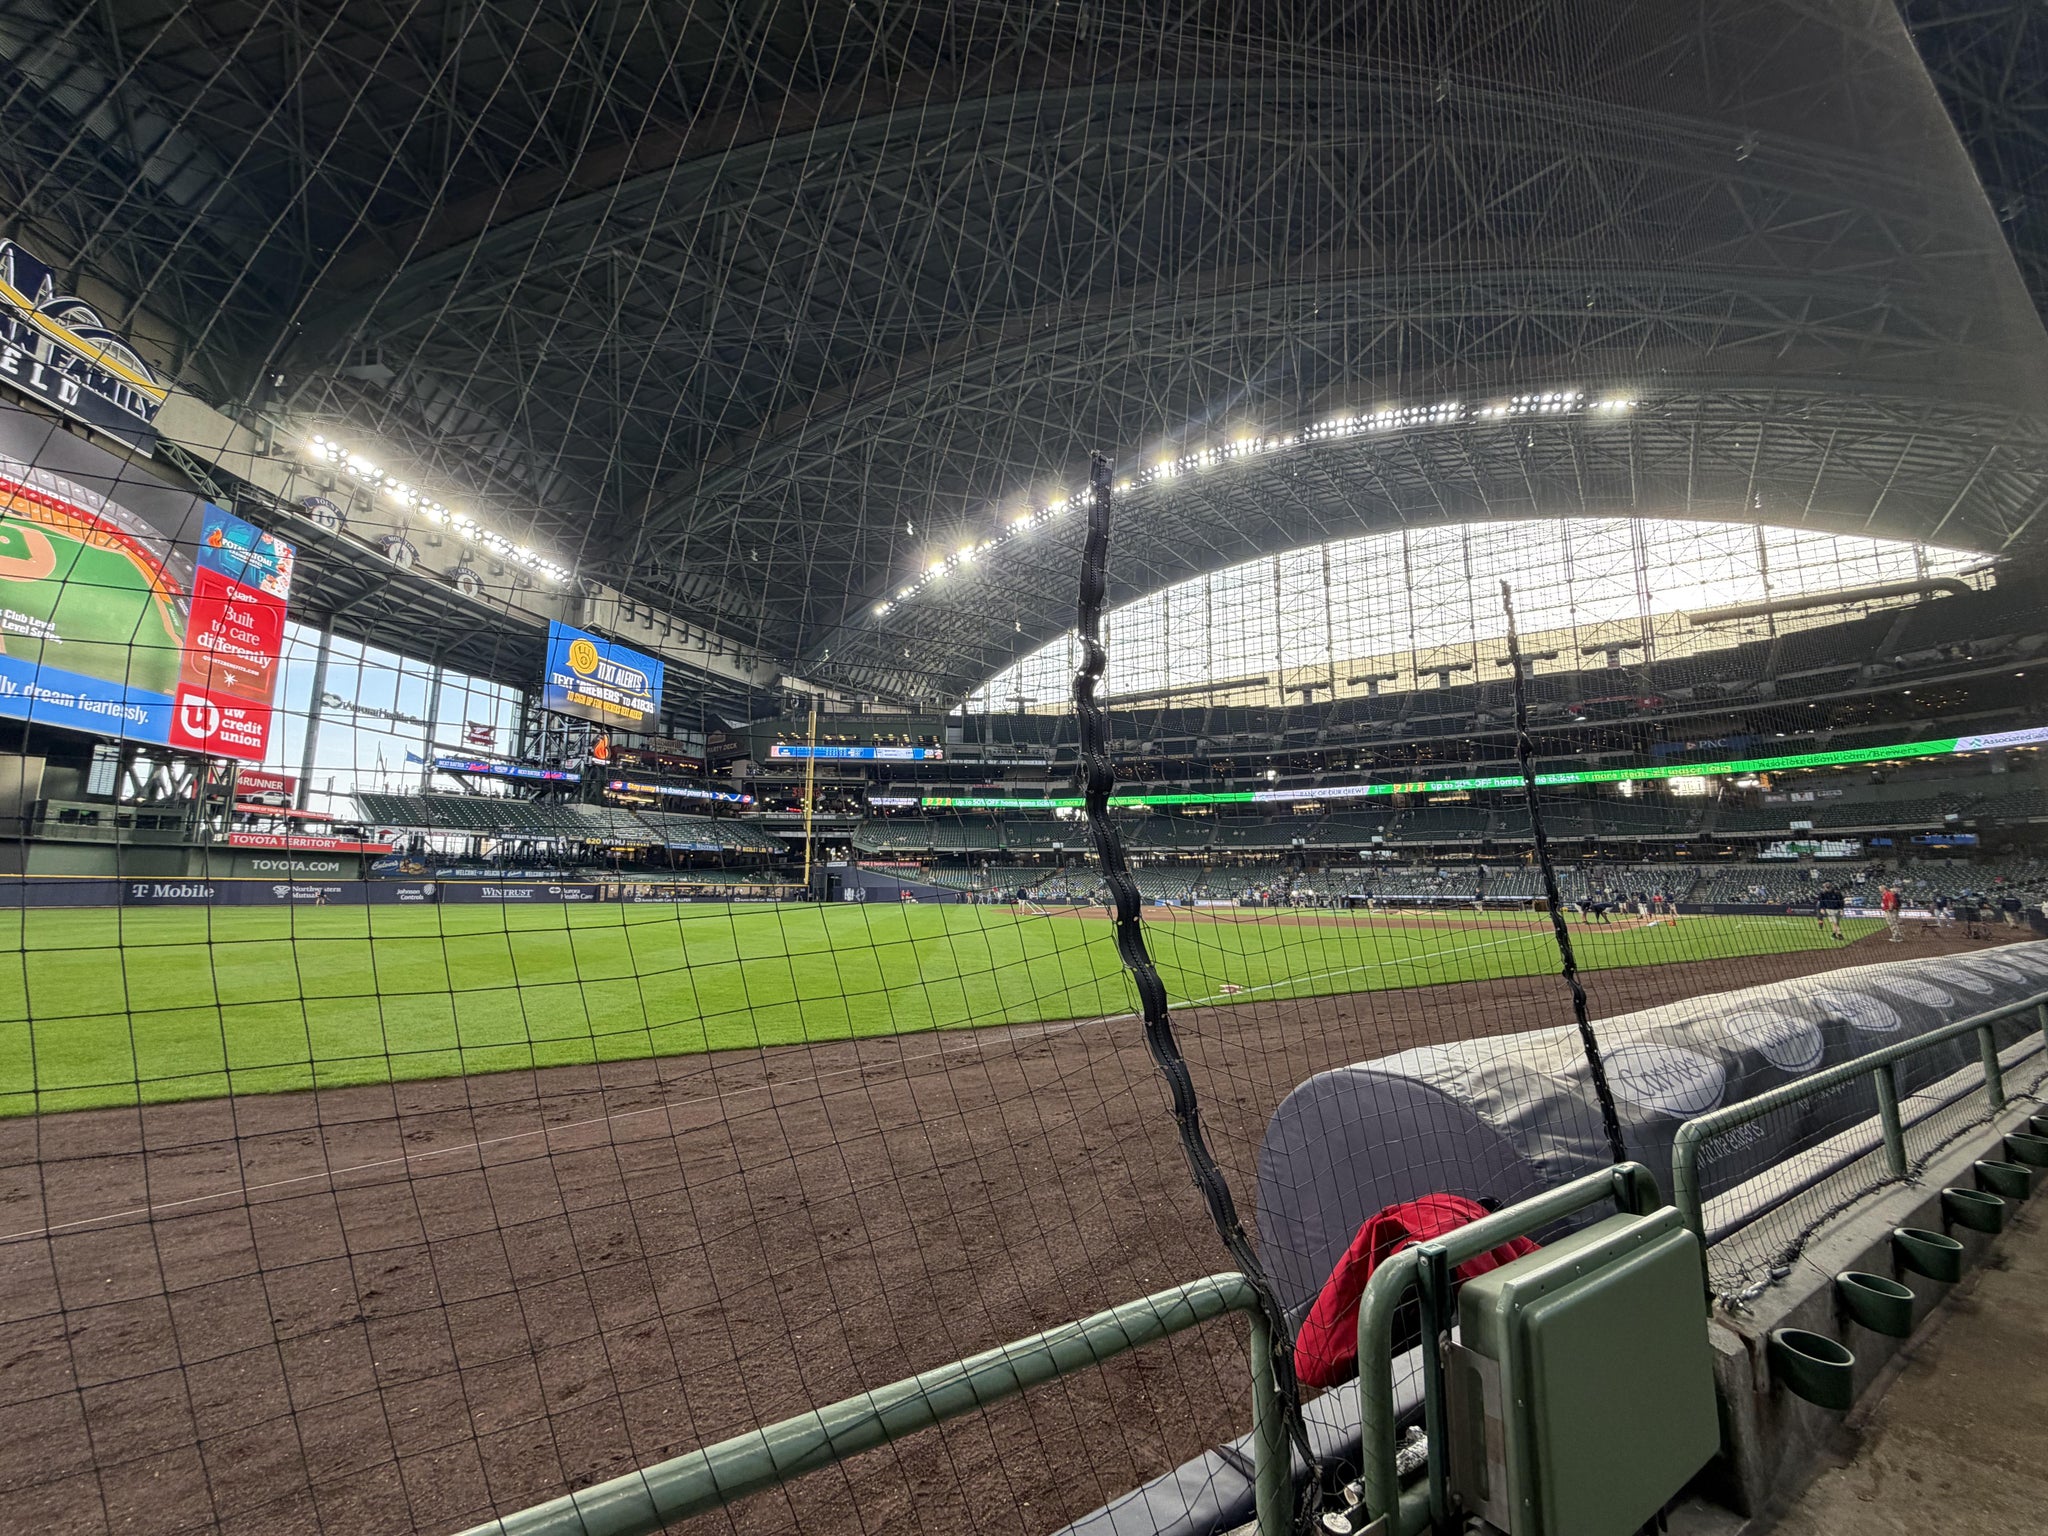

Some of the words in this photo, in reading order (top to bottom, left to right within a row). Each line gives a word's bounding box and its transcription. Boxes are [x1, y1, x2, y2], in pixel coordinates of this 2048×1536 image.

[315, 497, 340, 514] YOUNT
[388, 536, 415, 552] MOLTOR
[226, 585, 258, 603] Quartz
[4, 609, 28, 624] Club
[29, 615, 55, 631] Level
[223, 604, 255, 629] Built
[2, 618, 29, 635] Level
[211, 619, 226, 633] to
[229, 627, 260, 646] care
[197, 632, 272, 668] differently
[553, 672, 574, 690] TEXT
[614, 668, 642, 691] ALERTS
[24, 681, 74, 708] dream
[77, 693, 149, 725] fearlessly.
[223, 707, 247, 719] uw
[221, 716, 263, 736] credit
[219, 730, 262, 748] union
[1699, 738, 1728, 749] PNC
[1983, 733, 2031, 745] Associated
[1758, 746, 1919, 768] AssociatedBank.com/Brewers
[237, 776, 284, 791] 4RUNNER
[626, 782, 640, 791] Stay
[233, 835, 278, 845] TOYOTA
[281, 836, 337, 848] TERRITORY
[586, 837, 601, 845] 620
[602, 838, 626, 846] WTMJ
[252, 860, 340, 872] TOYOTA.COM
[152, 884, 214, 898] Mobile
[481, 887, 533, 897] WINTRUST
[1618, 1056, 1709, 1097] Carrier
[1727, 1120, 1765, 1151] experts
